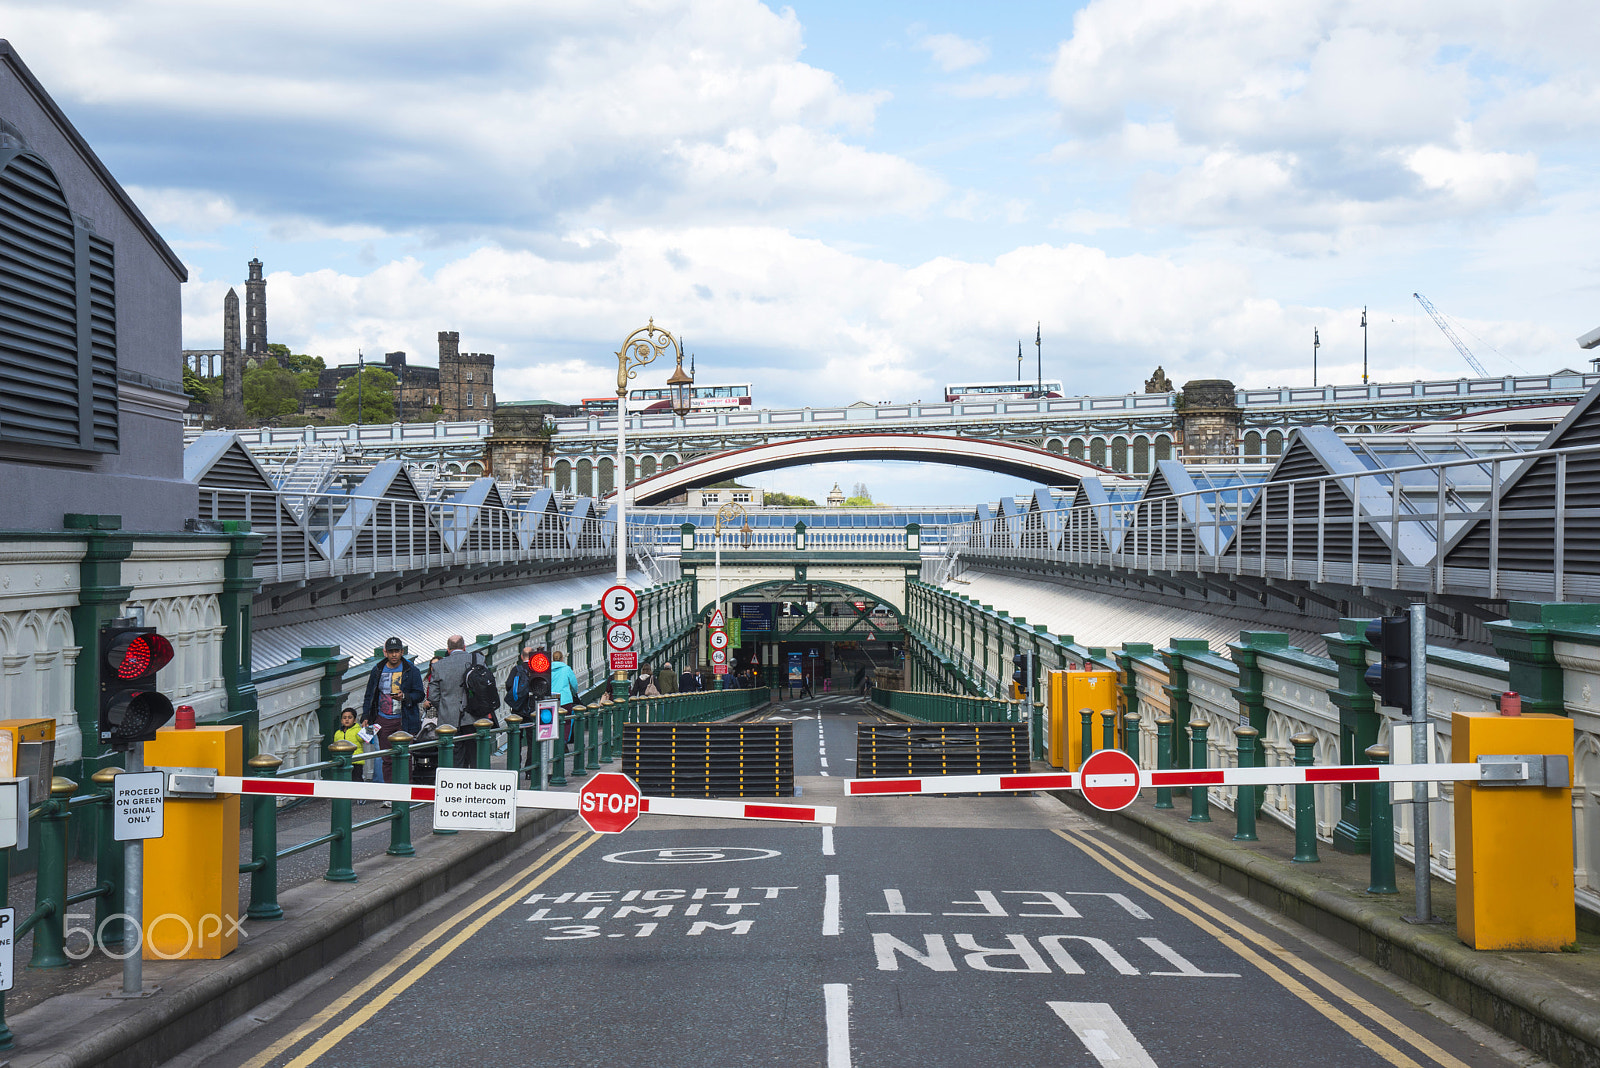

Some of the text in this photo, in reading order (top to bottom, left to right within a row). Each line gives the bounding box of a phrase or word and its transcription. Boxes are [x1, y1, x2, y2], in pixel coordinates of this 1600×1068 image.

[614, 596, 625, 612] 5
[119, 788, 160, 796] PROCEED
[440, 780, 512, 792] Do not back up
[465, 796, 506, 805] intercom
[582, 792, 637, 814] STOP
[452, 810, 486, 818] contact
[489, 811, 510, 819] staff
[655, 849, 726, 861] 5
[523, 886, 798, 904] HEIGHT
[526, 902, 760, 922] LIMIT
[866, 888, 1154, 920] LEFT
[544, 920, 756, 940] 3.1 M
[872, 932, 1242, 978] TURN
